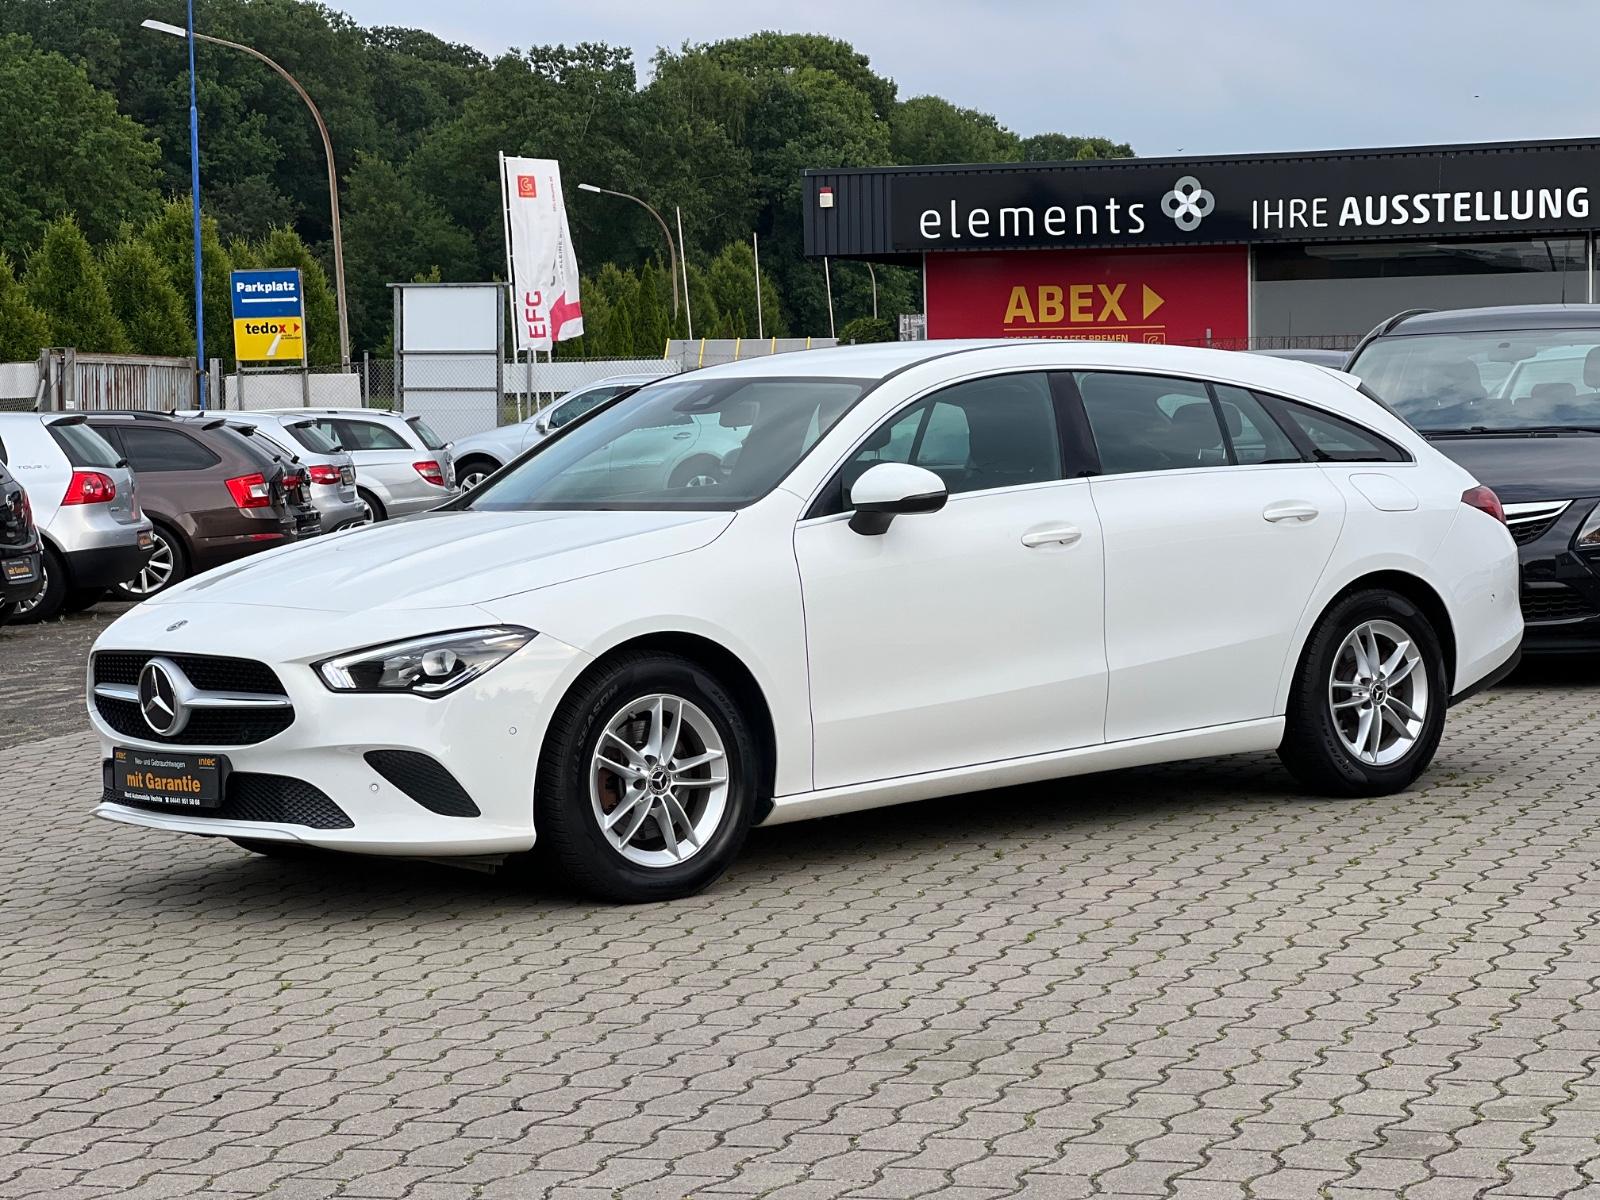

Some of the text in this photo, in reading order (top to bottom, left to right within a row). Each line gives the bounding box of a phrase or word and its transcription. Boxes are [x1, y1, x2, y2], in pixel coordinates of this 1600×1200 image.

[919, 197, 1145, 239] elements
[1252, 187, 1589, 230] IHRE AUSSTELLUNG
[236, 281, 295, 293] Parkplatz
[1003, 284, 1128, 323] ABEX
[245, 322, 286, 334] tedox
[126, 771, 201, 793] mit Garantie
